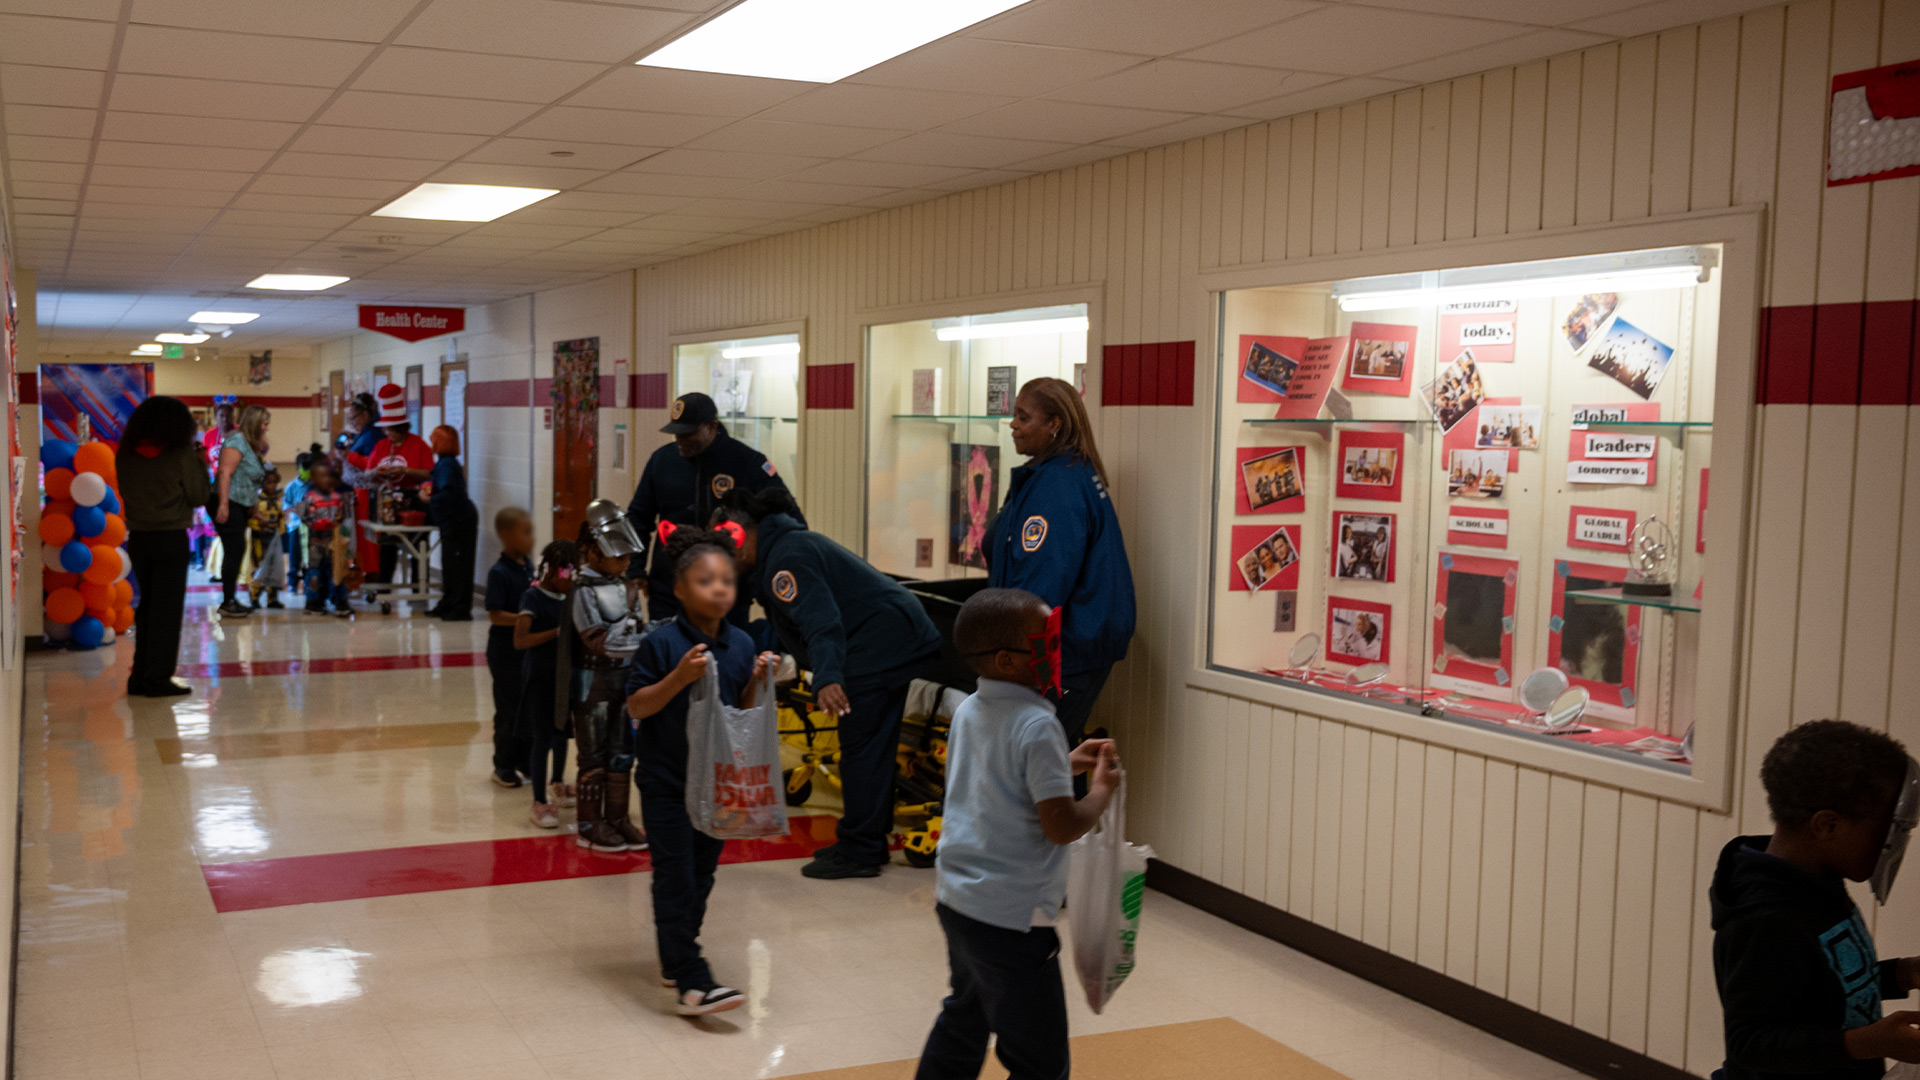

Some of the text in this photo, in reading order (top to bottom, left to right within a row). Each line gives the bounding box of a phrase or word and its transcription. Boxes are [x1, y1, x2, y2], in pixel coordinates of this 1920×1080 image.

[375, 311, 448, 329] Health Center
[1464, 325, 1510, 340] today.
[1573, 408, 1626, 425] global
[1588, 438, 1652, 453] leaders
[1578, 465, 1646, 476] tomorrow.
[1455, 520, 1495, 529] SCHOLAR
[1584, 518, 1623, 529] GLOBAL
[1583, 530, 1621, 541] LEADER
